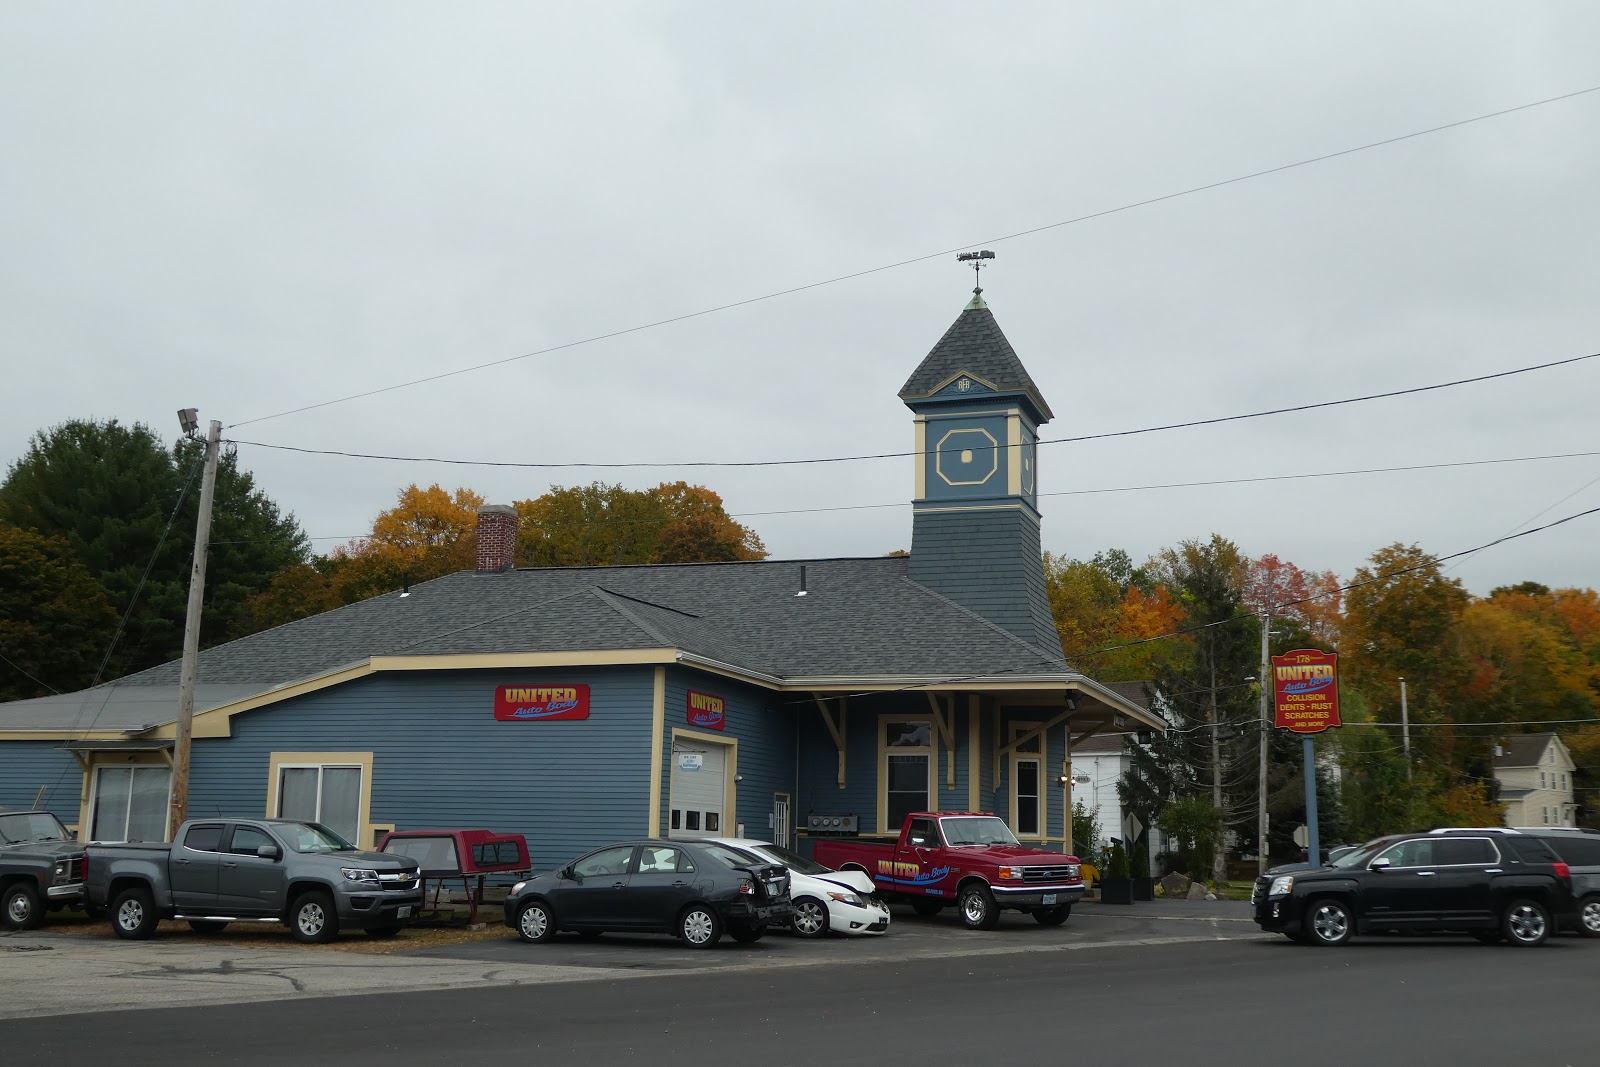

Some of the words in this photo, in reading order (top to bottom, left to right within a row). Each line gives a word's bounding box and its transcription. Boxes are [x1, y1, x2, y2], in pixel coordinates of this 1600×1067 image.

[1296, 655, 1310, 663] 178
[1276, 665, 1333, 681] UNITED
[1284, 682, 1306, 692] Auto
[1309, 676, 1334, 686] Body
[505, 688, 577, 703] UNITED
[690, 692, 723, 713] UNITED
[513, 707, 543, 716] Auto
[546, 700, 579, 711] Body
[1280, 703, 1305, 711] DENTS
[1284, 711, 1330, 719] SCRATCHES
[694, 713, 708, 721] Auto
[708, 711, 723, 721] Body
[878, 859, 920, 878] UNITED
[914, 873, 930, 882] Auto
[931, 865, 950, 878] Body
